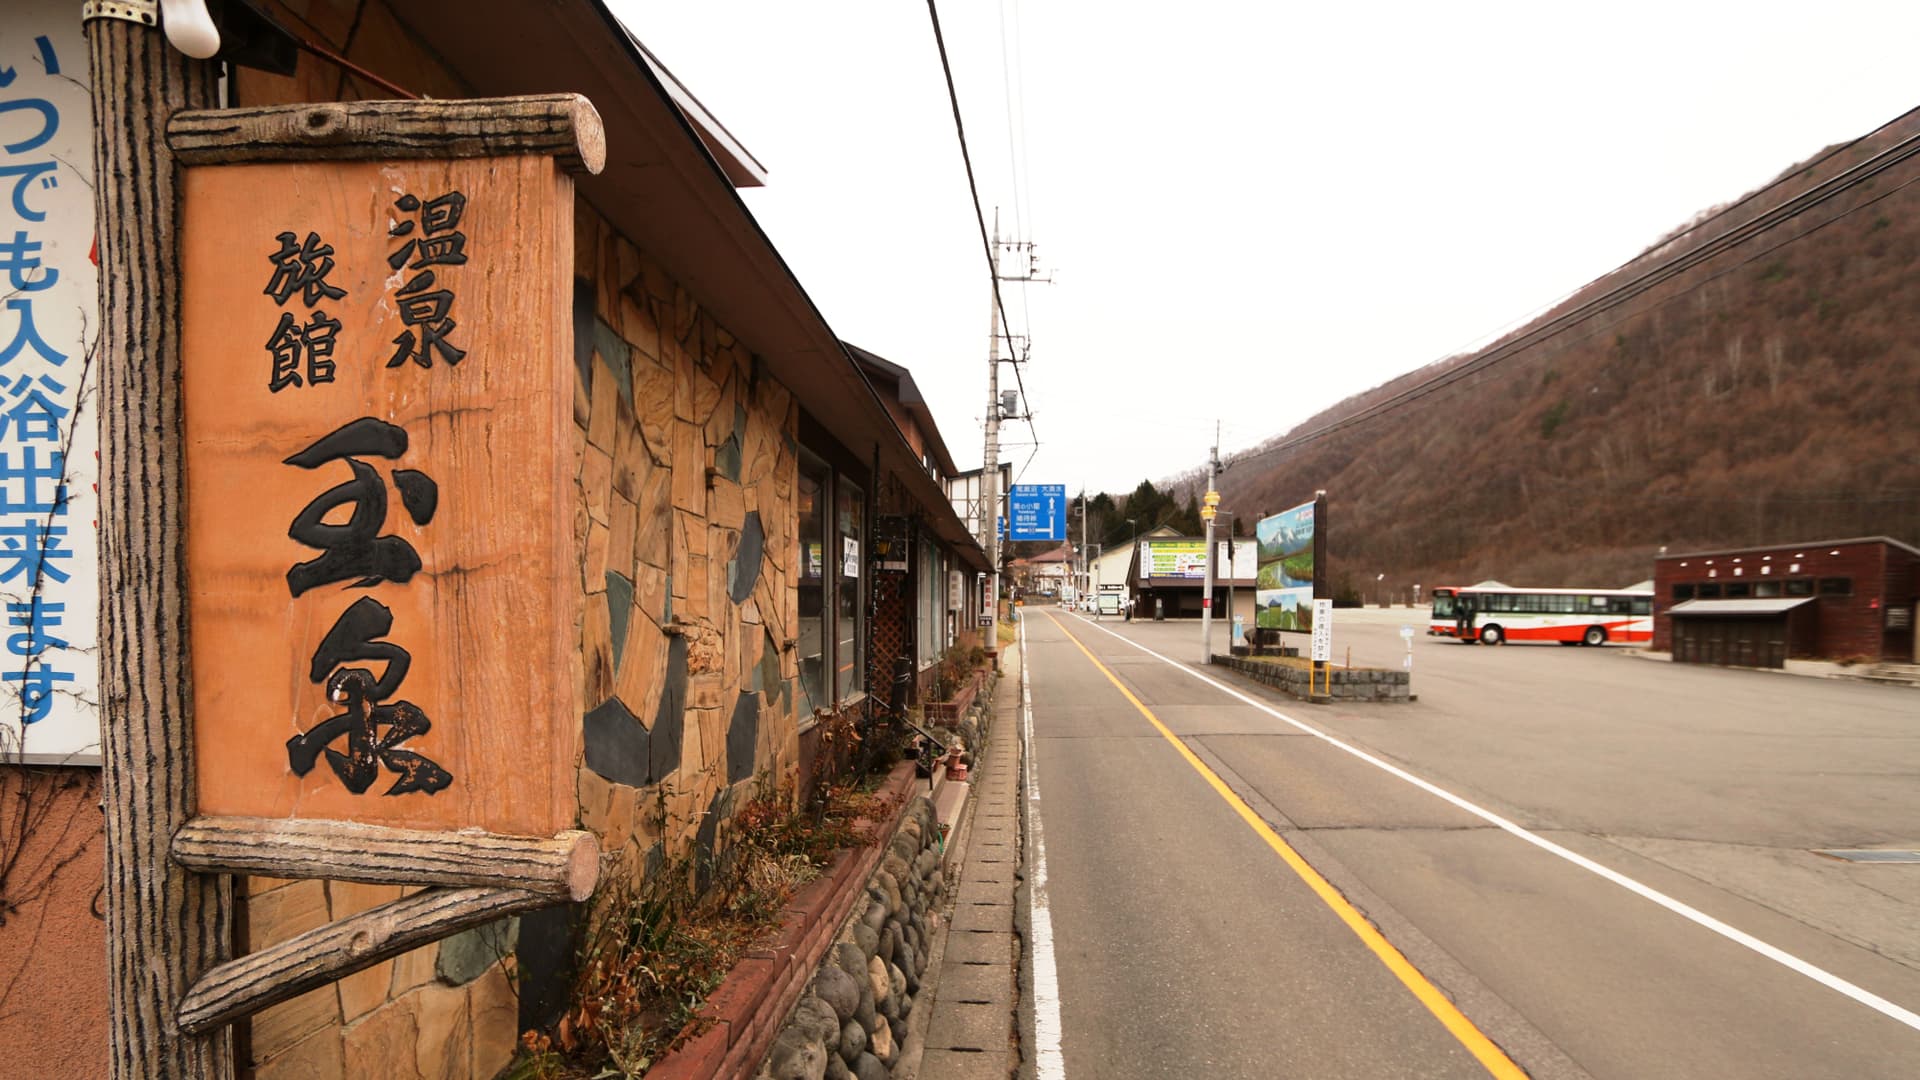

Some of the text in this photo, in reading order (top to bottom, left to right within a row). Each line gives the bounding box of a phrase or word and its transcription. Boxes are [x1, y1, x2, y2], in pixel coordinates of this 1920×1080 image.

[0, 35, 75, 726] いつでも入浴出来ます
[263, 231, 348, 393] 旅館
[385, 191, 468, 369] 温泉
[282, 416, 453, 796] 玉泉
